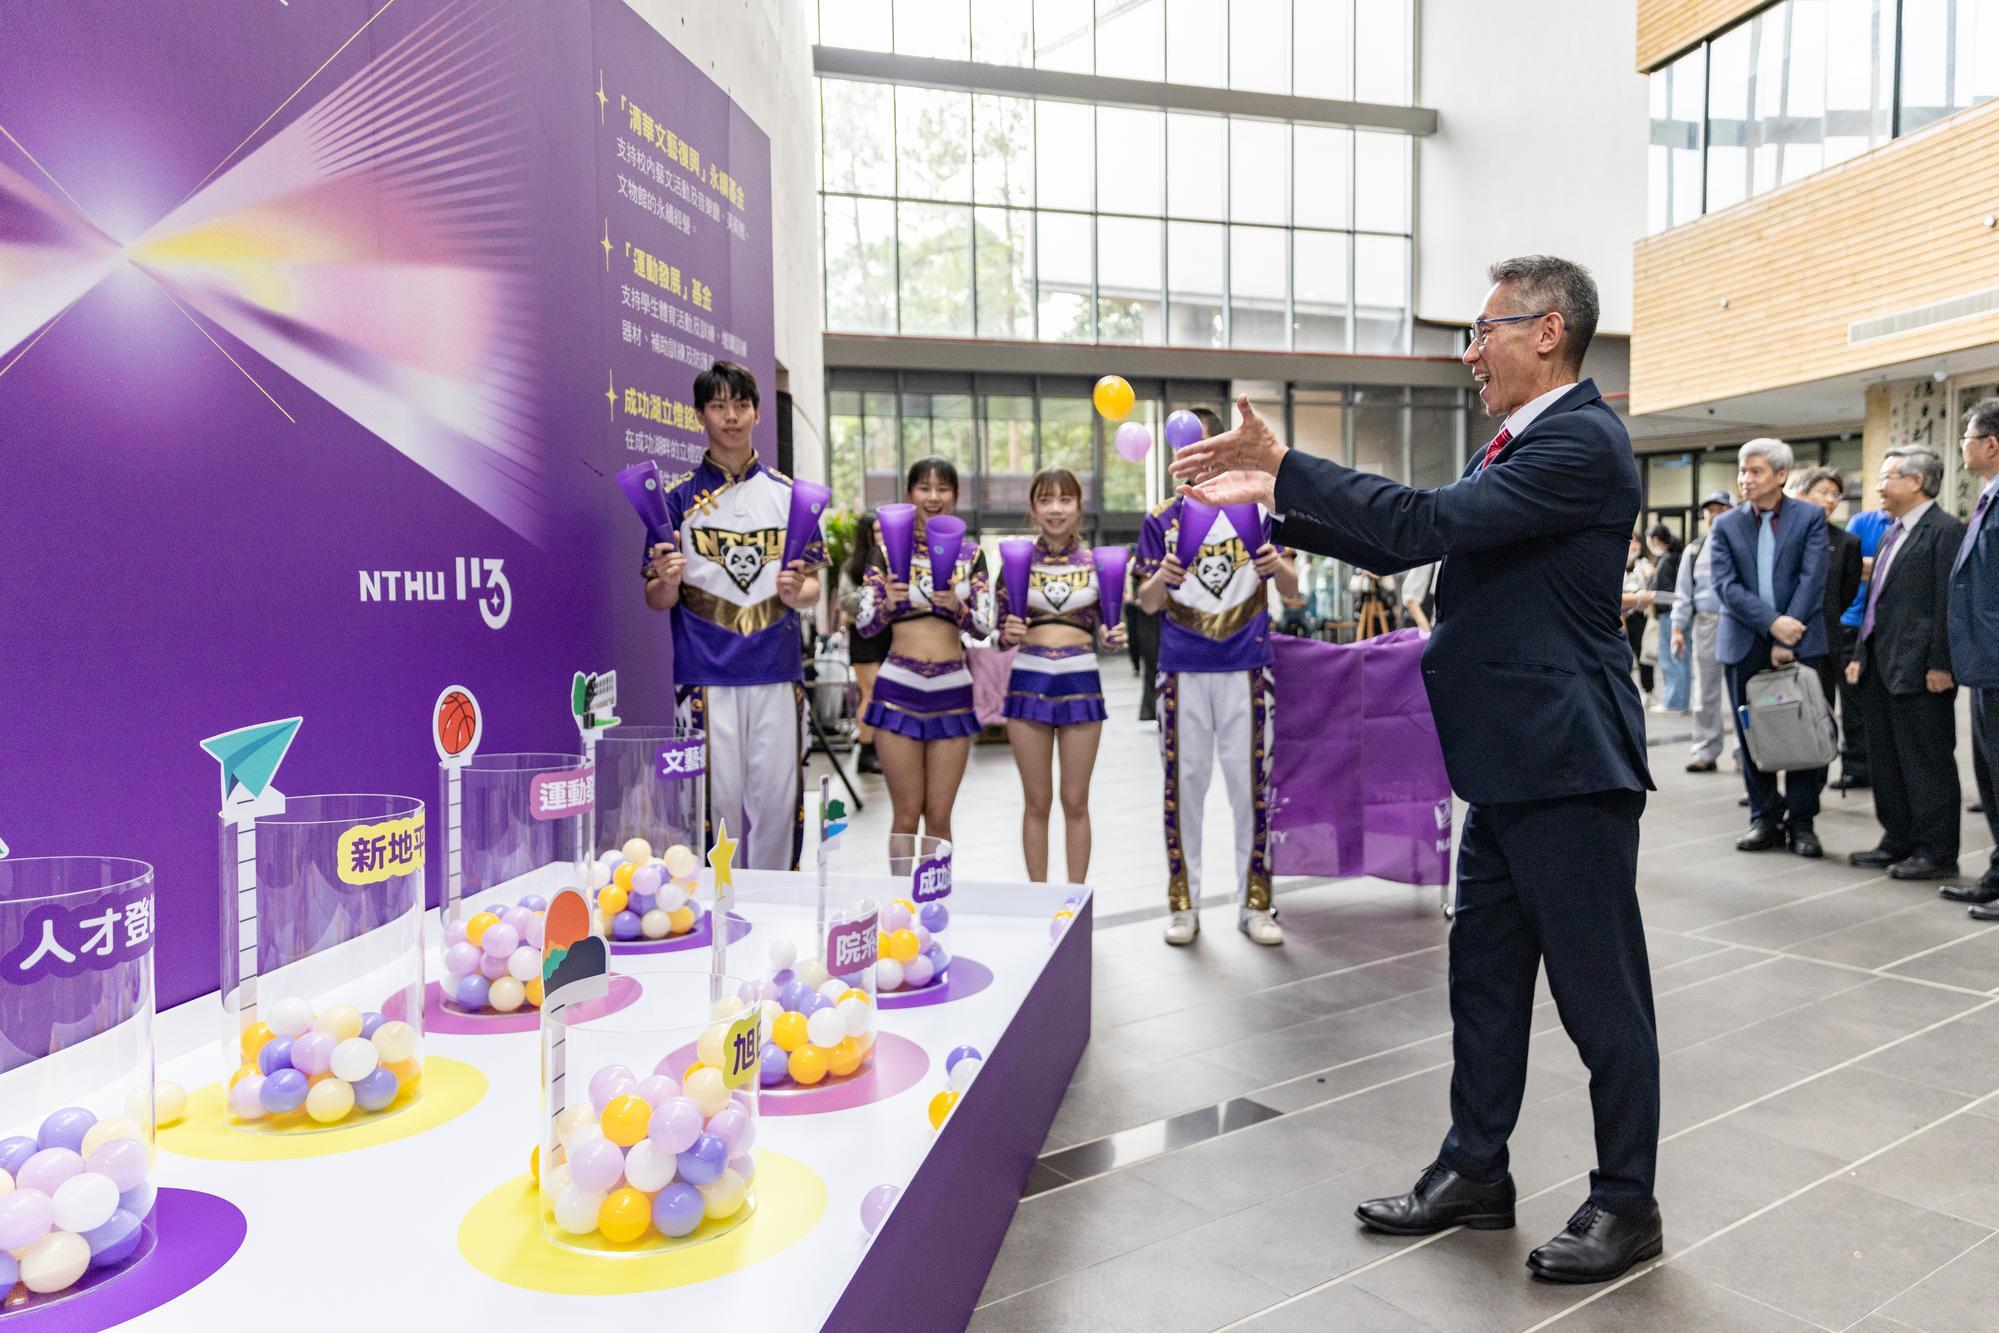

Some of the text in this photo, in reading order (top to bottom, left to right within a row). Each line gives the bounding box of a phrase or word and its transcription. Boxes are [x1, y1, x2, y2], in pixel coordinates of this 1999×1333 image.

[358, 556, 512, 630] NTHU 113
[19, 894, 154, 970] 人才登
